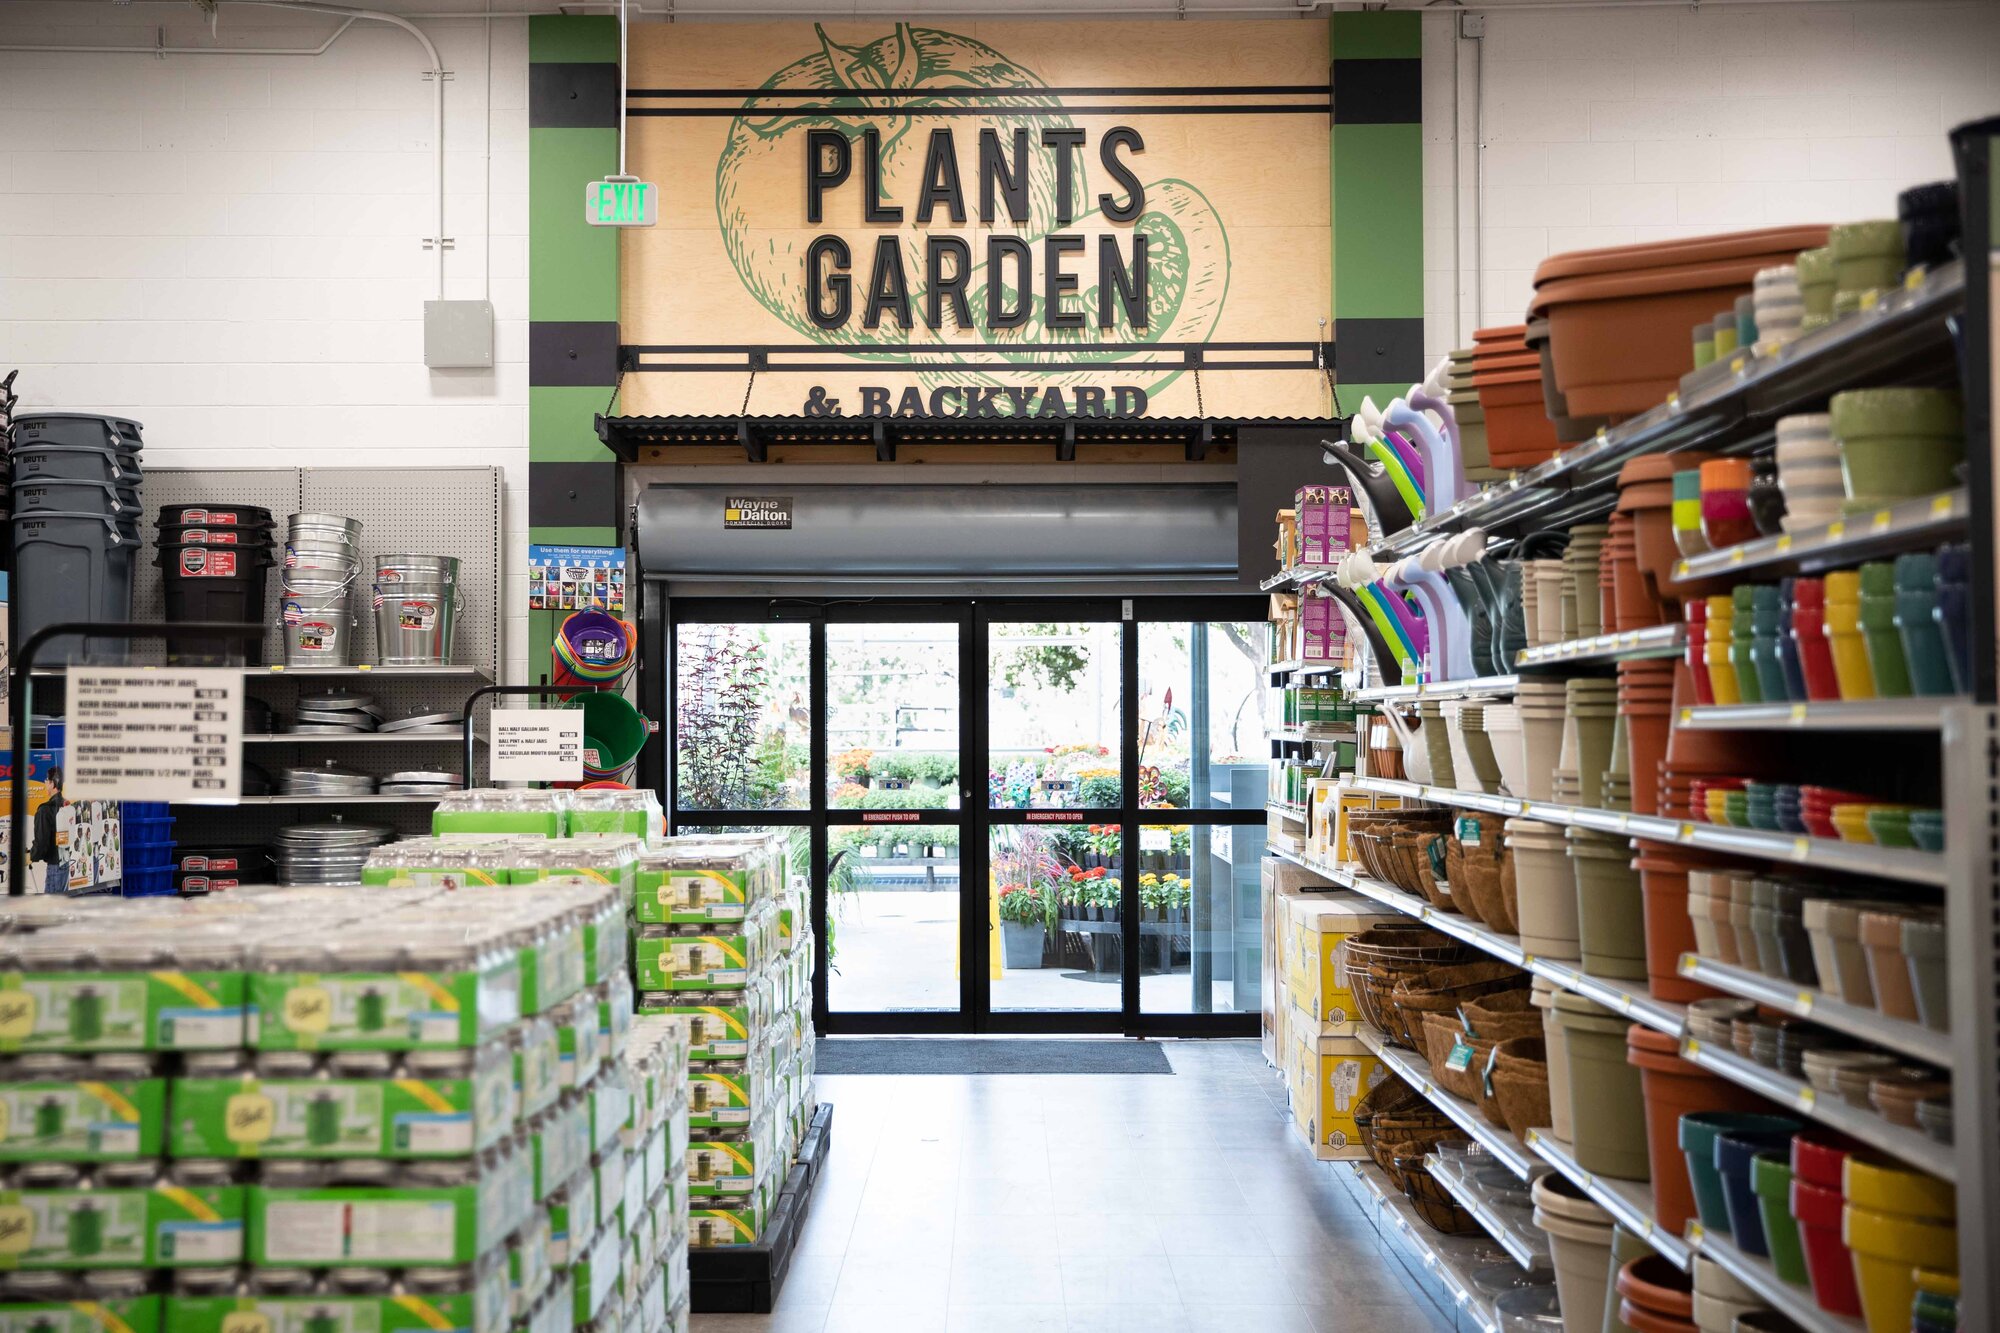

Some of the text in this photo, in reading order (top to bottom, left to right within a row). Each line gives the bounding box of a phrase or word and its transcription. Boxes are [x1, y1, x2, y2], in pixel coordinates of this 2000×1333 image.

[807, 126, 1146, 222] PLANTS
[598, 184, 648, 222] EXIT
[806, 234, 1148, 329] GARDEN
[803, 385, 1148, 418] & BACKYARD
[23, 421, 47, 430] BRUTE
[23, 455, 47, 463] BRUTE
[23, 488, 48, 497] BRUTE
[730, 499, 778, 511] Wayne
[22, 521, 46, 529] BRUTE
[100, 678, 122, 686] WIDE
[124, 679, 154, 687] MOUTH
[156, 679, 175, 687] PINT
[78, 701, 99, 709] KERR
[101, 701, 139, 709] REGULAR
[141, 702, 172, 710] MOUTH
[173, 702, 192, 710] PINT
[77, 723, 99, 731] KERR
[101, 723, 123, 731] WIDE
[125, 724, 156, 732] MOUTH
[158, 724, 176, 732] PINT
[77, 745, 98, 753] KERR
[100, 745, 137, 753] REGULAR
[138, 746, 169, 754] MOUTH
[185, 746, 204, 754] PINT
[76, 768, 98, 776] KERR
[100, 768, 122, 776] WIDE
[124, 768, 155, 776] MOUTH
[172, 769, 191, 777] PINT
